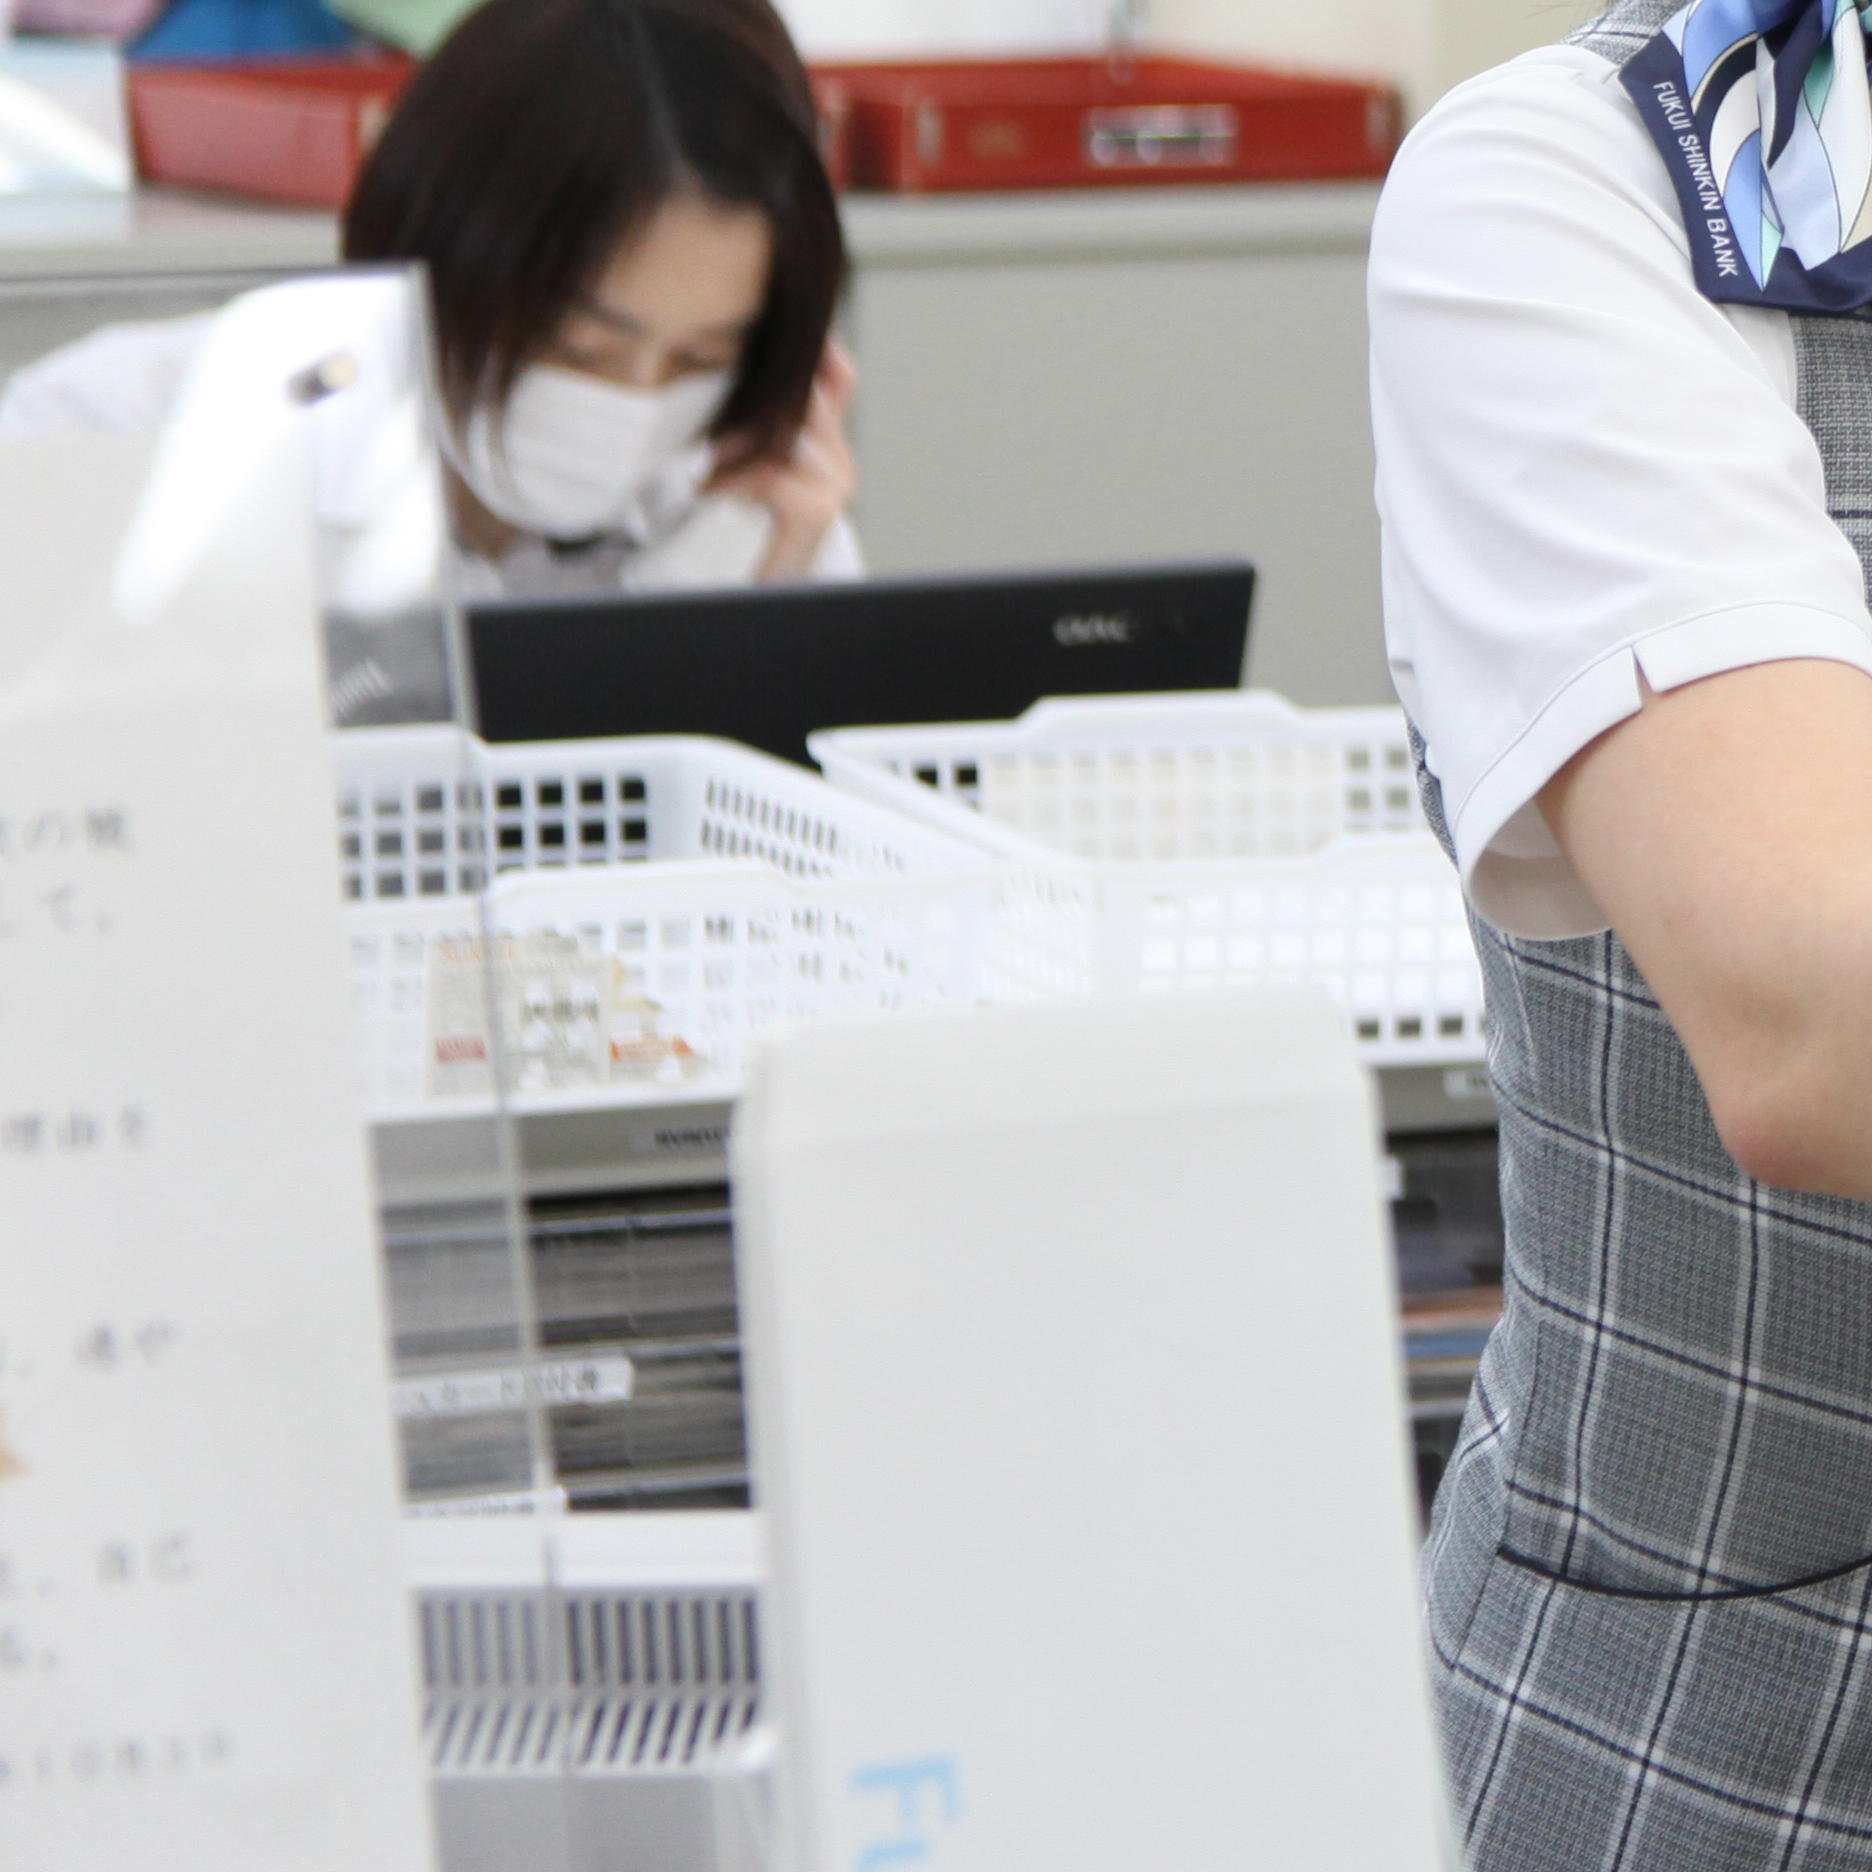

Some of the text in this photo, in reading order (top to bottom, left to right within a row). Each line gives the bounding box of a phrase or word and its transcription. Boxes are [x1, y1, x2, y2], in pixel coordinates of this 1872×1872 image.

[1653, 81, 1740, 278] FUKUI SHINKIN BANK
